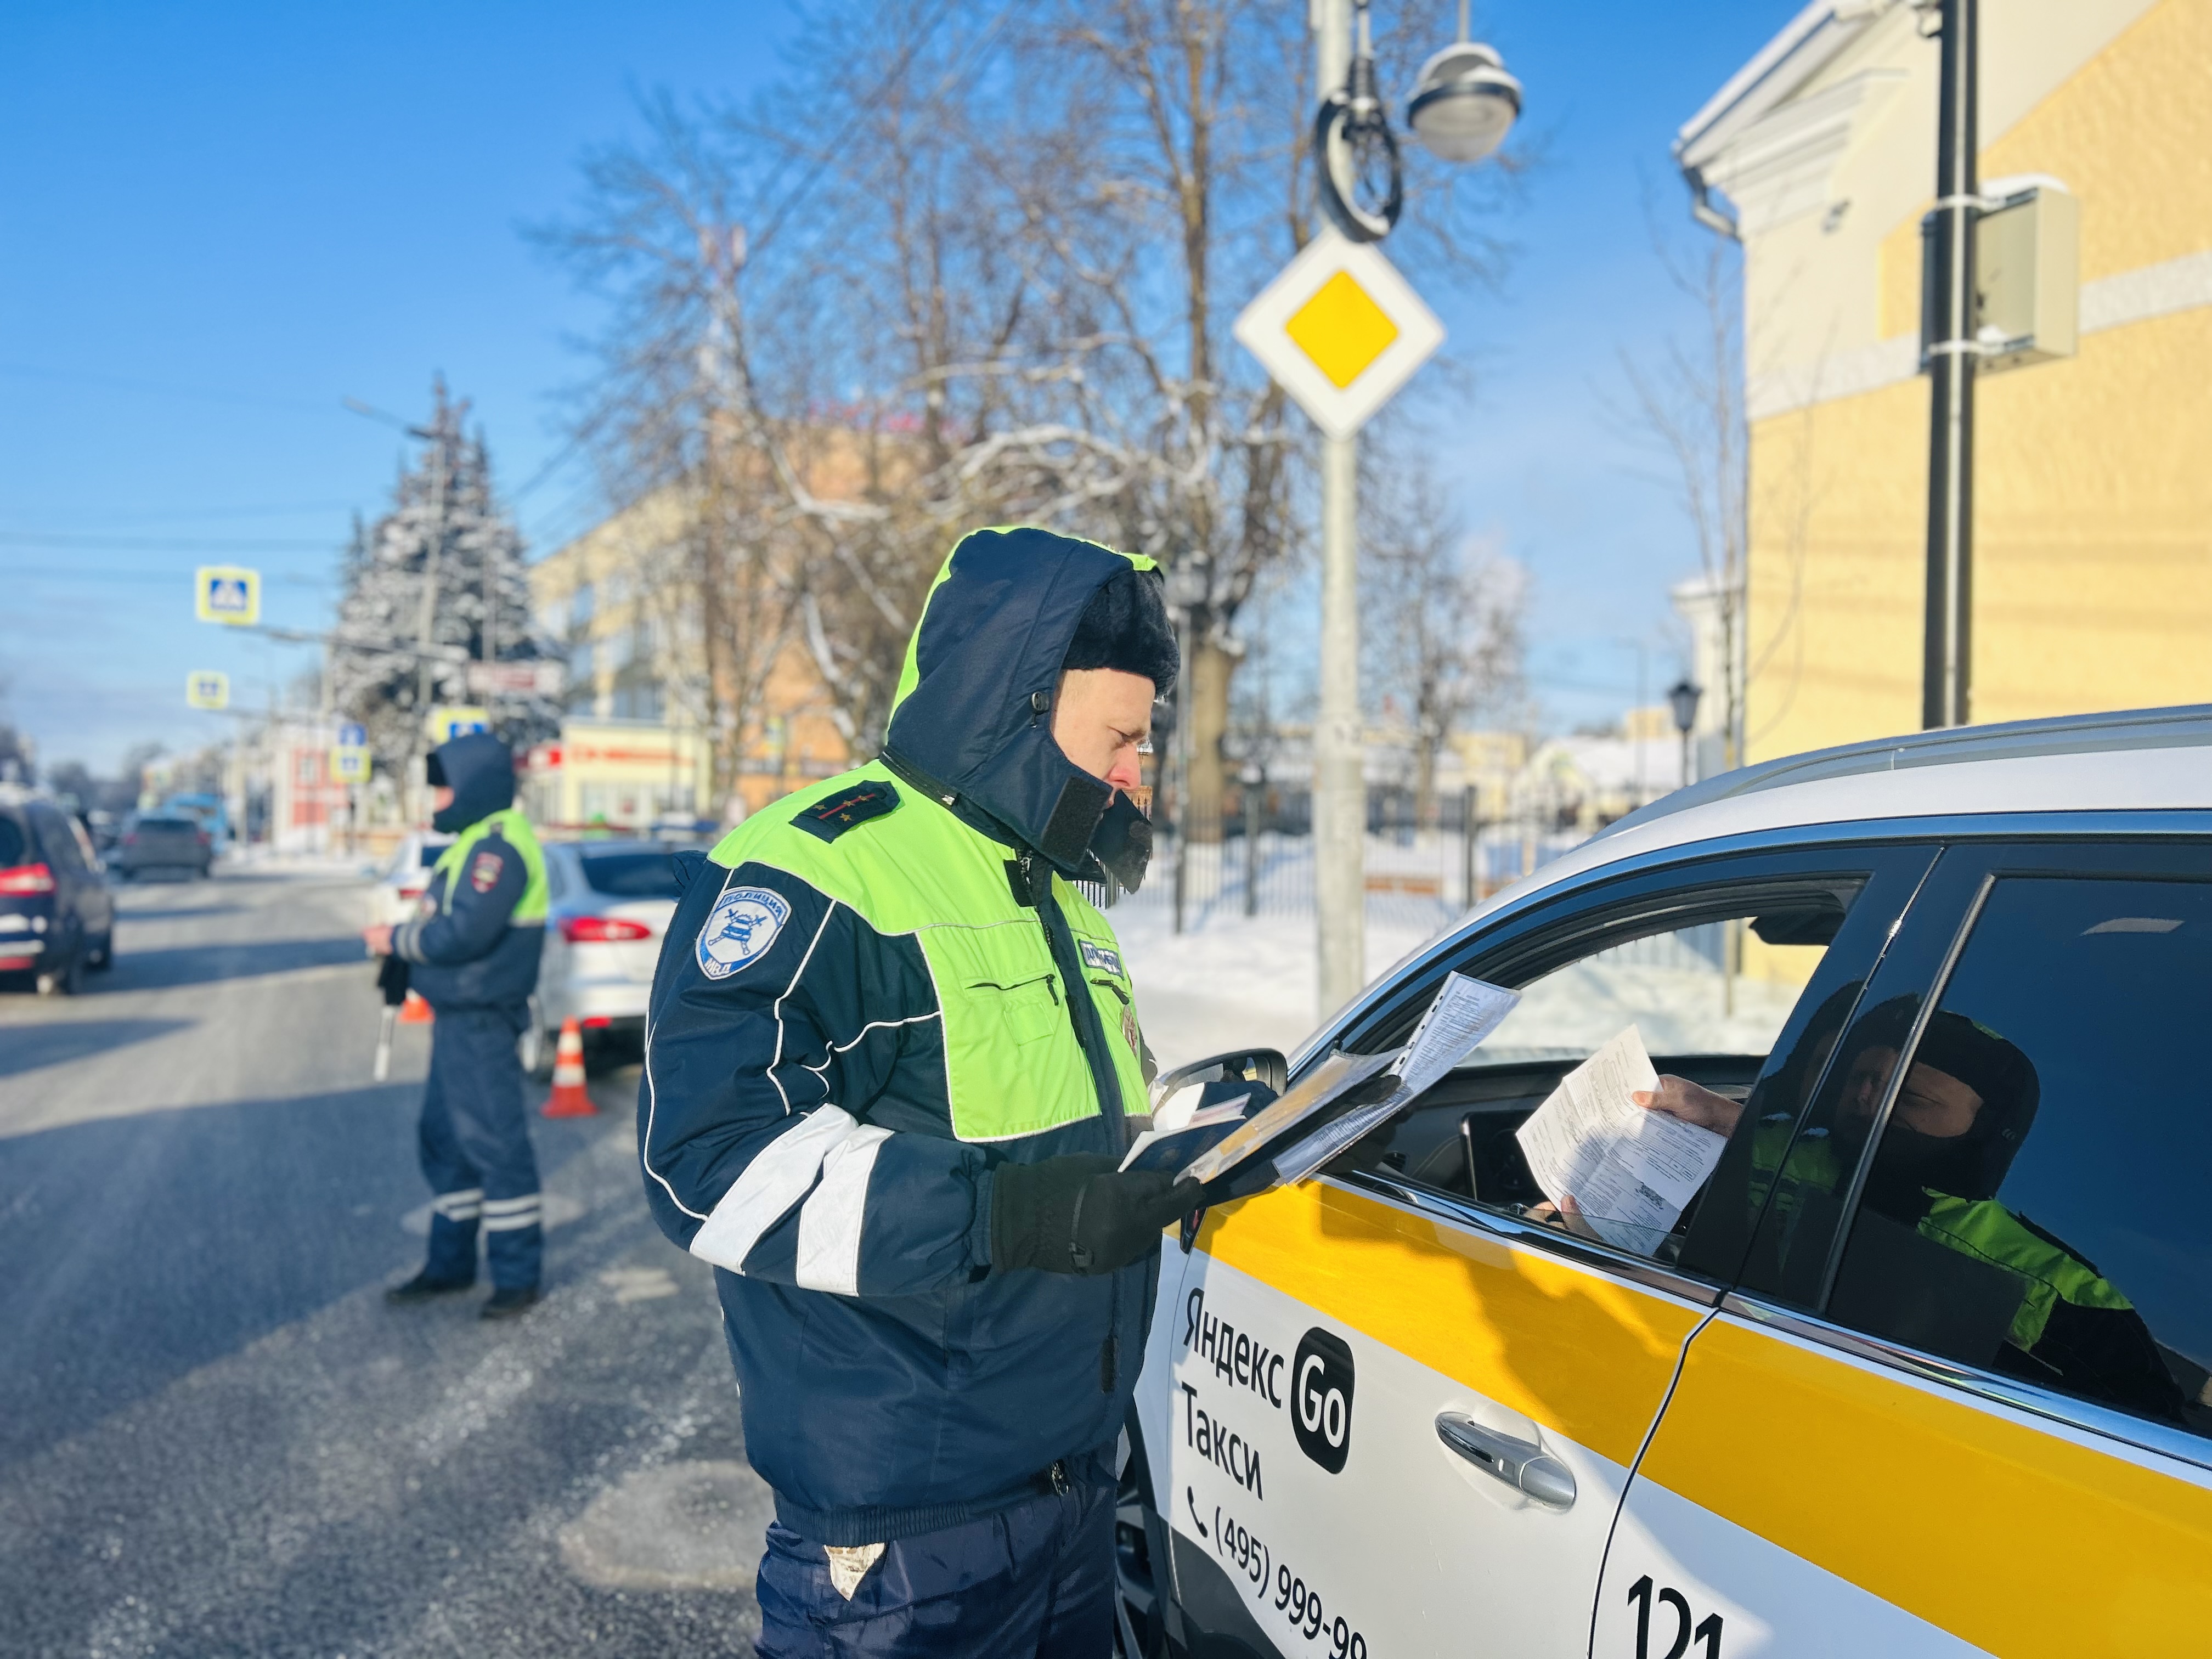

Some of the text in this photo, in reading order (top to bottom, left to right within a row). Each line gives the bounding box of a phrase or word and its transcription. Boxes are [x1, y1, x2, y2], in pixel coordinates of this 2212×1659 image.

[723, 892, 783, 917] ПОЛИЦИЯ
[704, 957, 732, 976] МВД
[1183, 1287, 1347, 1448] Яндекс Go
[1181, 1381, 1263, 1502] Такси
[1215, 1506, 1269, 1599] (495)
